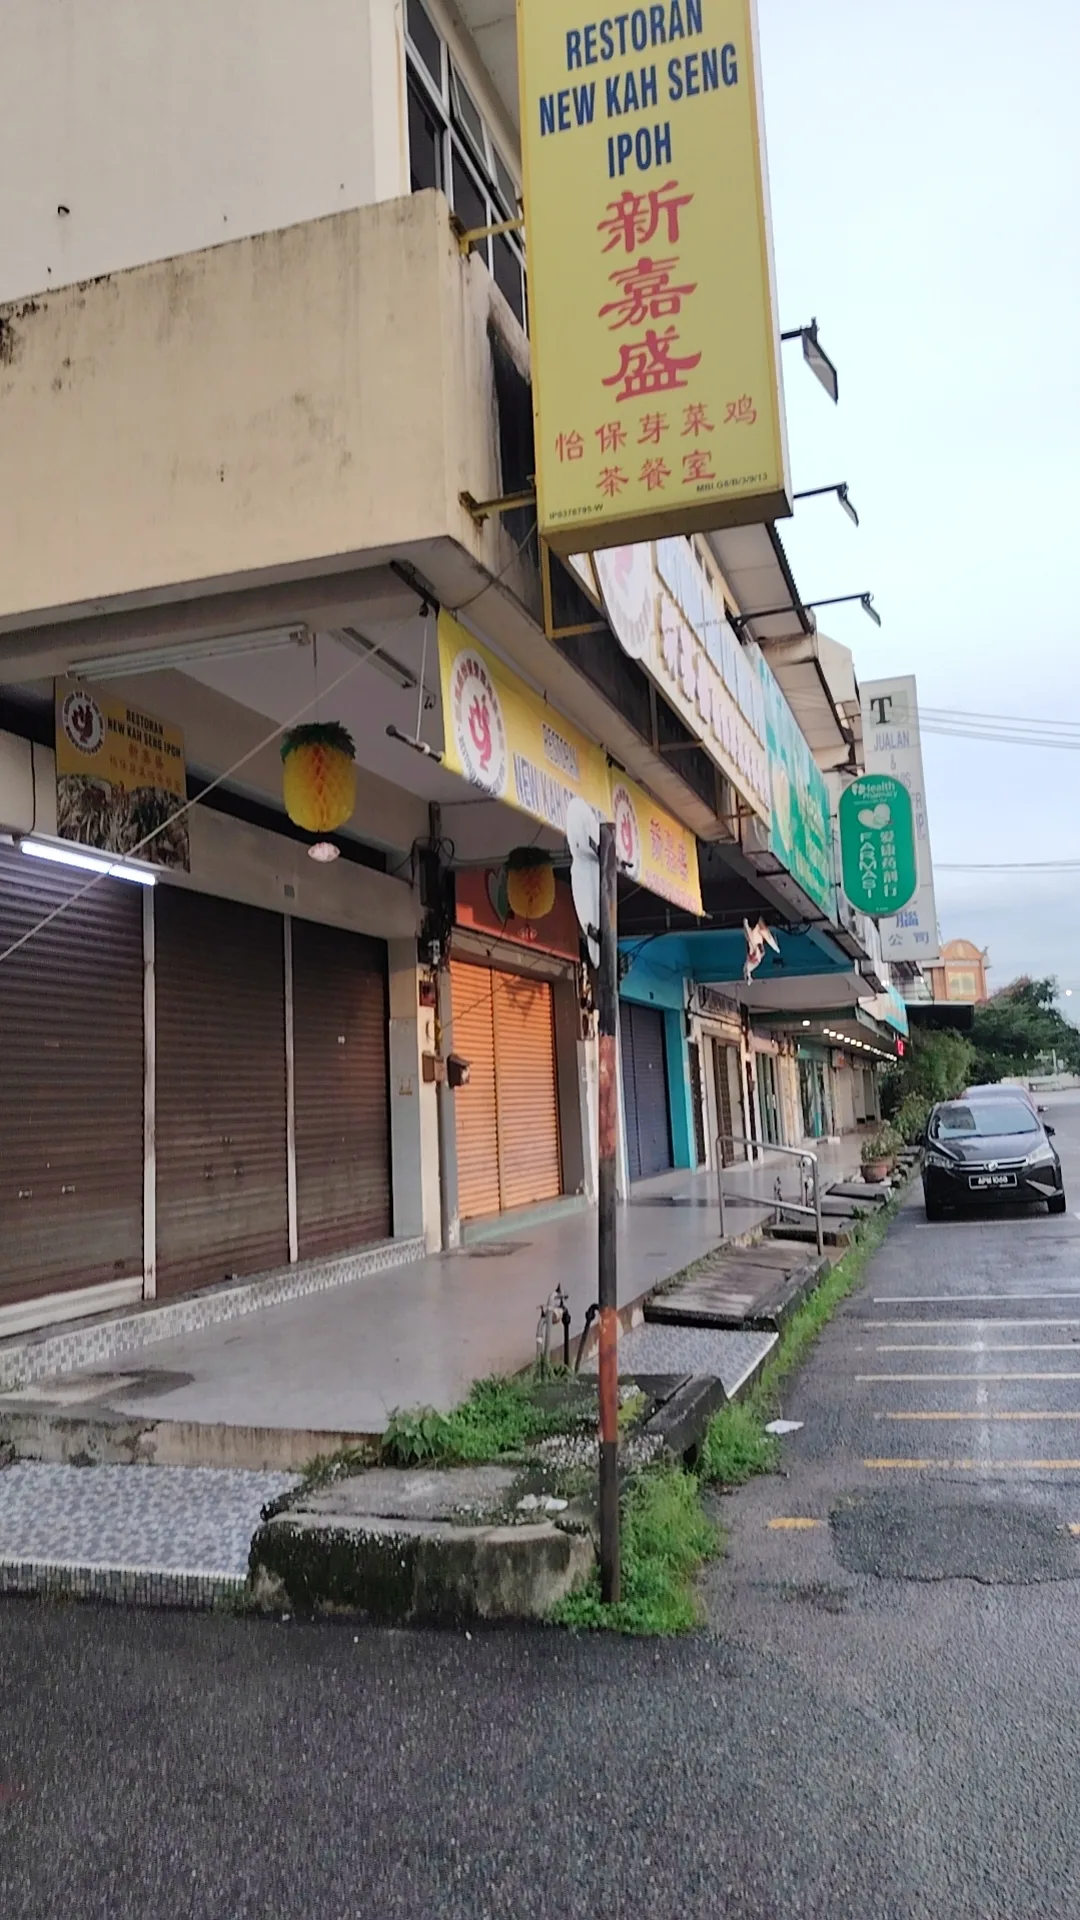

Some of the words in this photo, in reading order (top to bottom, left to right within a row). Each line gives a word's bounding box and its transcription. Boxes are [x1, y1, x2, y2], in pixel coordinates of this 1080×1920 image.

[565, 0, 703, 71] RESTORAN
[539, 82, 596, 137] NEW
[605, 64, 658, 119] KAH
[667, 42, 739, 101] SENG
[607, 121, 672, 179] IPOH
[597, 180, 703, 403] 新嘉盛
[555, 393, 758, 463] 怡保芽菜鸡
[595, 449, 717, 498] 茶餐室
[107, 716, 126, 737] NEW
[126, 724, 143, 744] KAH
[126, 709, 164, 736] RESTORAN
[874, 730, 911, 752] JUALAN
[859, 832, 878, 899] FARMASI
